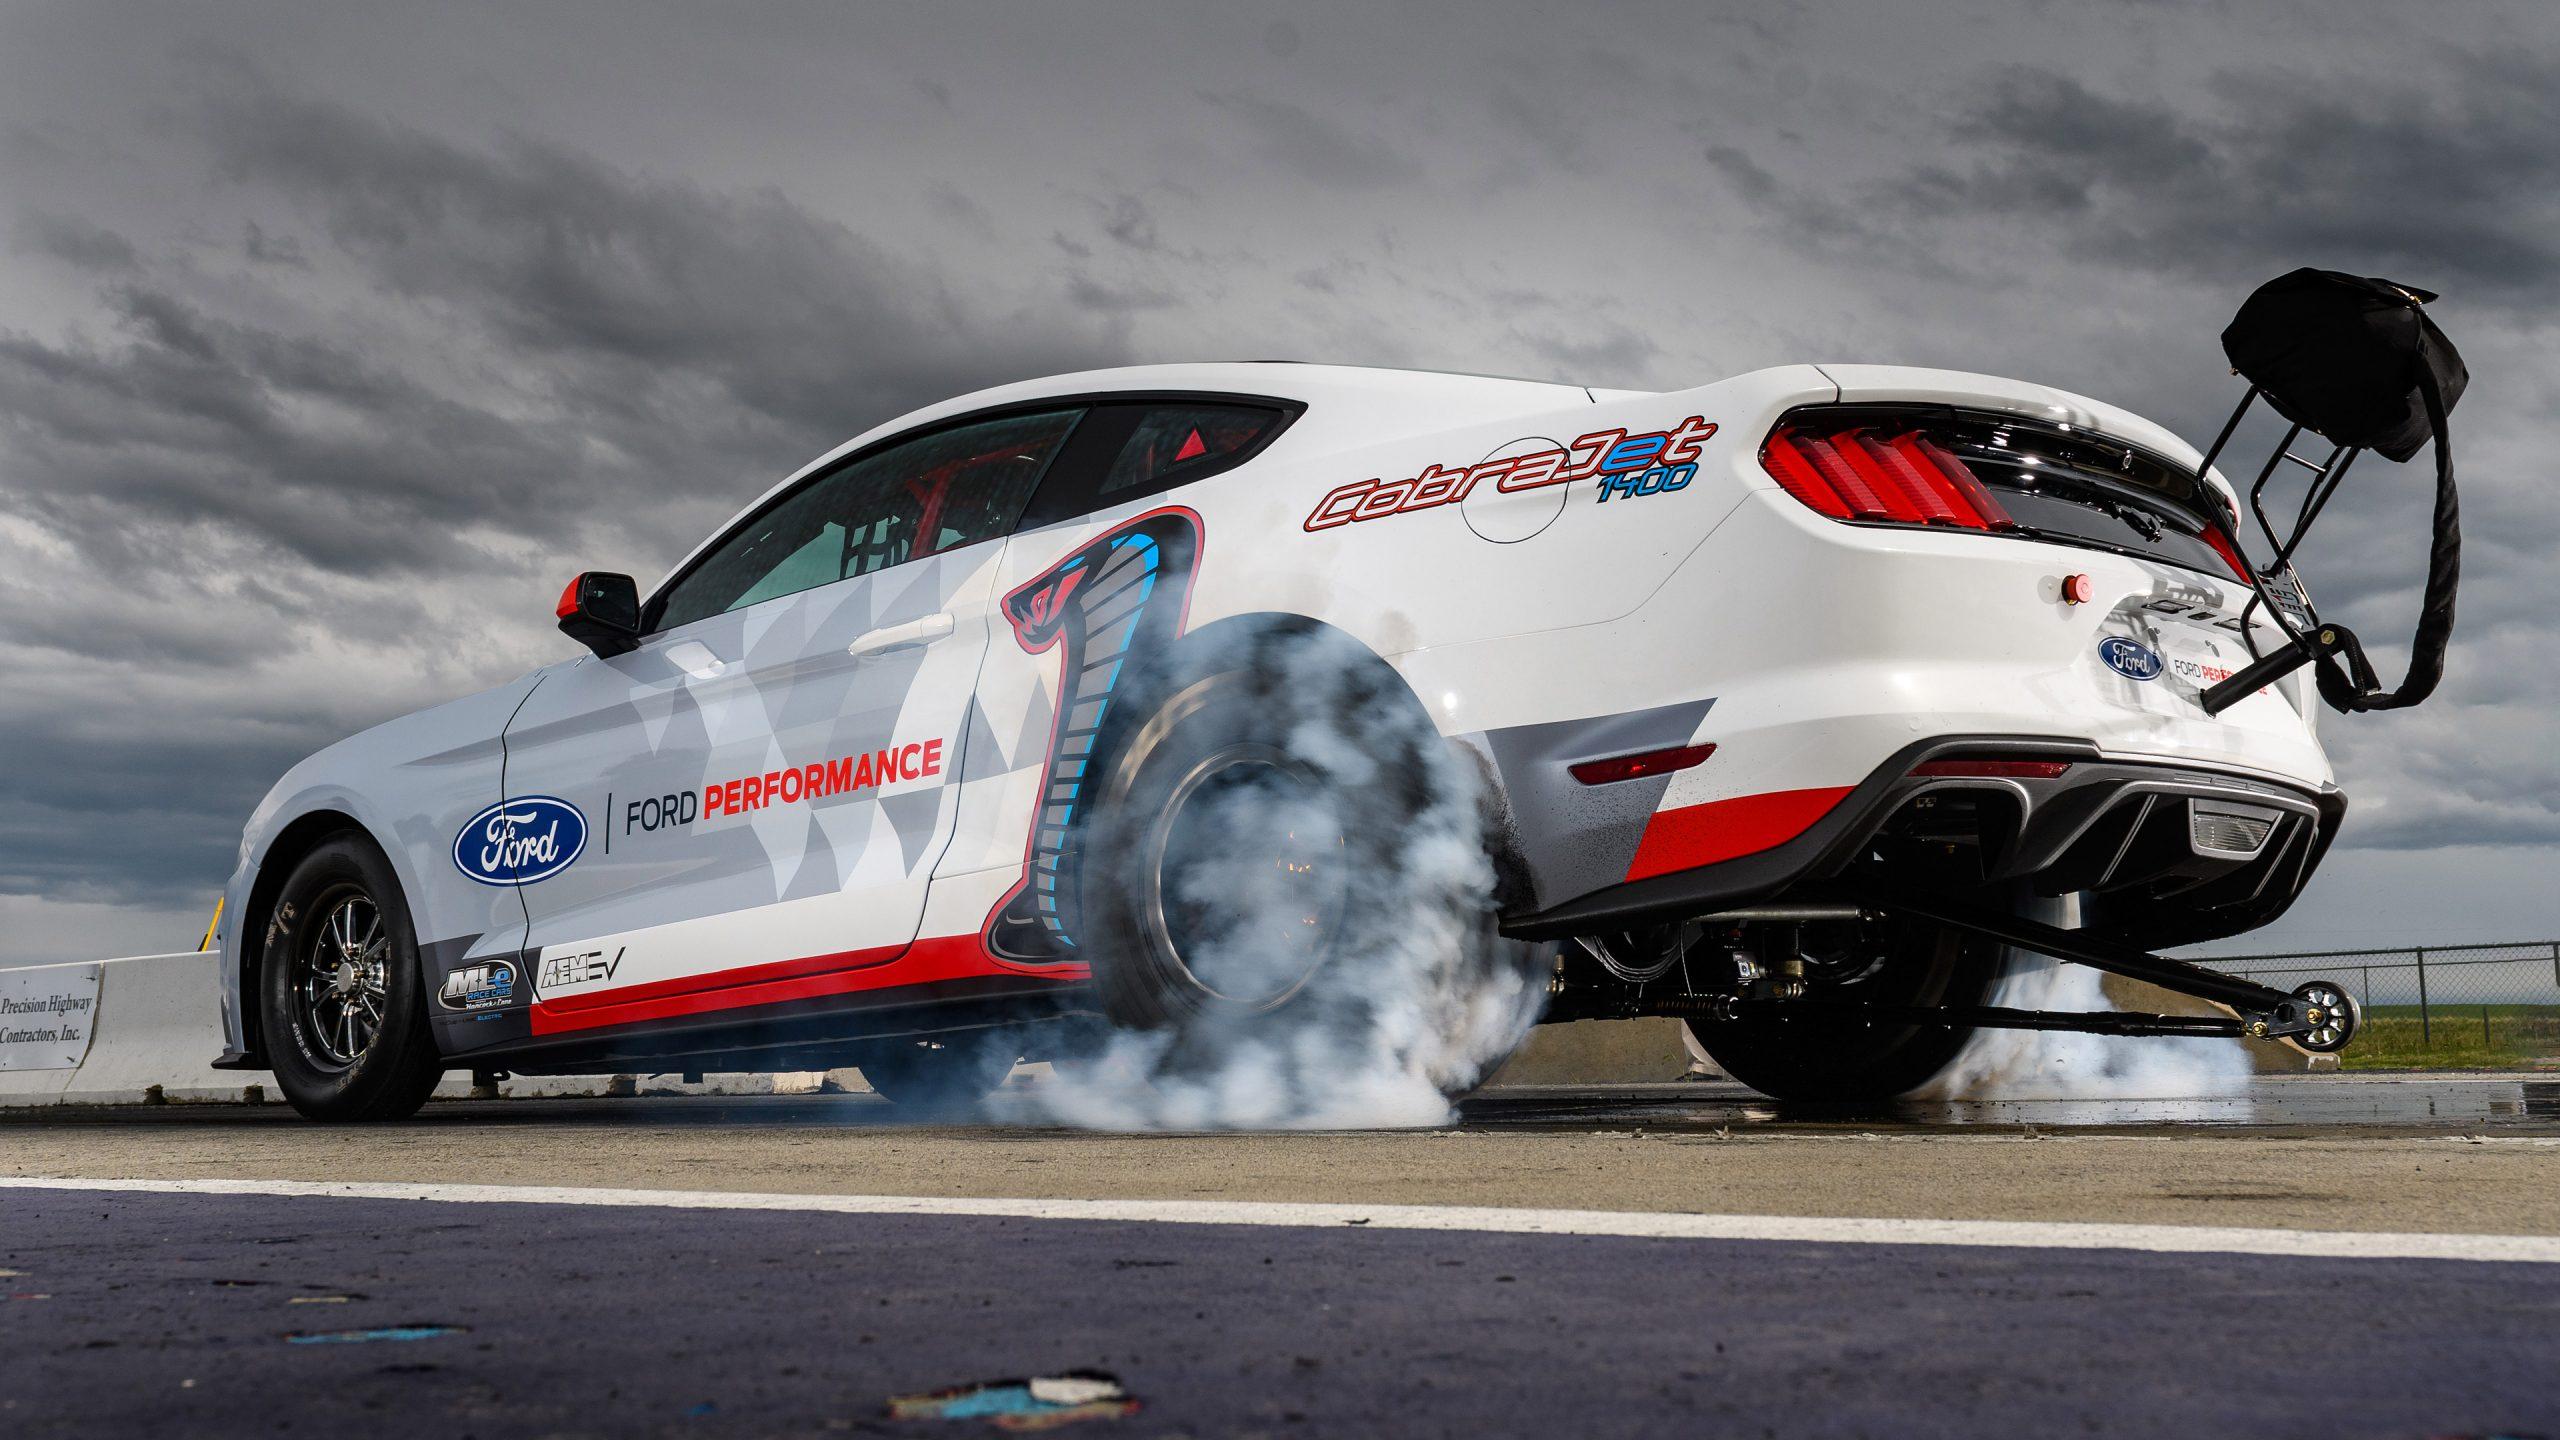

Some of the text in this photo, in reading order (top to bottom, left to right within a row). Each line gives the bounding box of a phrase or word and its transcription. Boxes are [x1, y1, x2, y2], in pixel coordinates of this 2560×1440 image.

[1596, 462, 1700, 503] 1400
[2112, 642, 2150, 674] Ford
[2174, 659, 2201, 679] FORD
[626, 738, 944, 836] FORD PERFORMANCE
[480, 810, 559, 872] Ford
[1, 993, 92, 1017] Precision Highway
[466, 987, 512, 1000] RACE CARS
[0, 1024, 80, 1044] Contractors, Inc.
